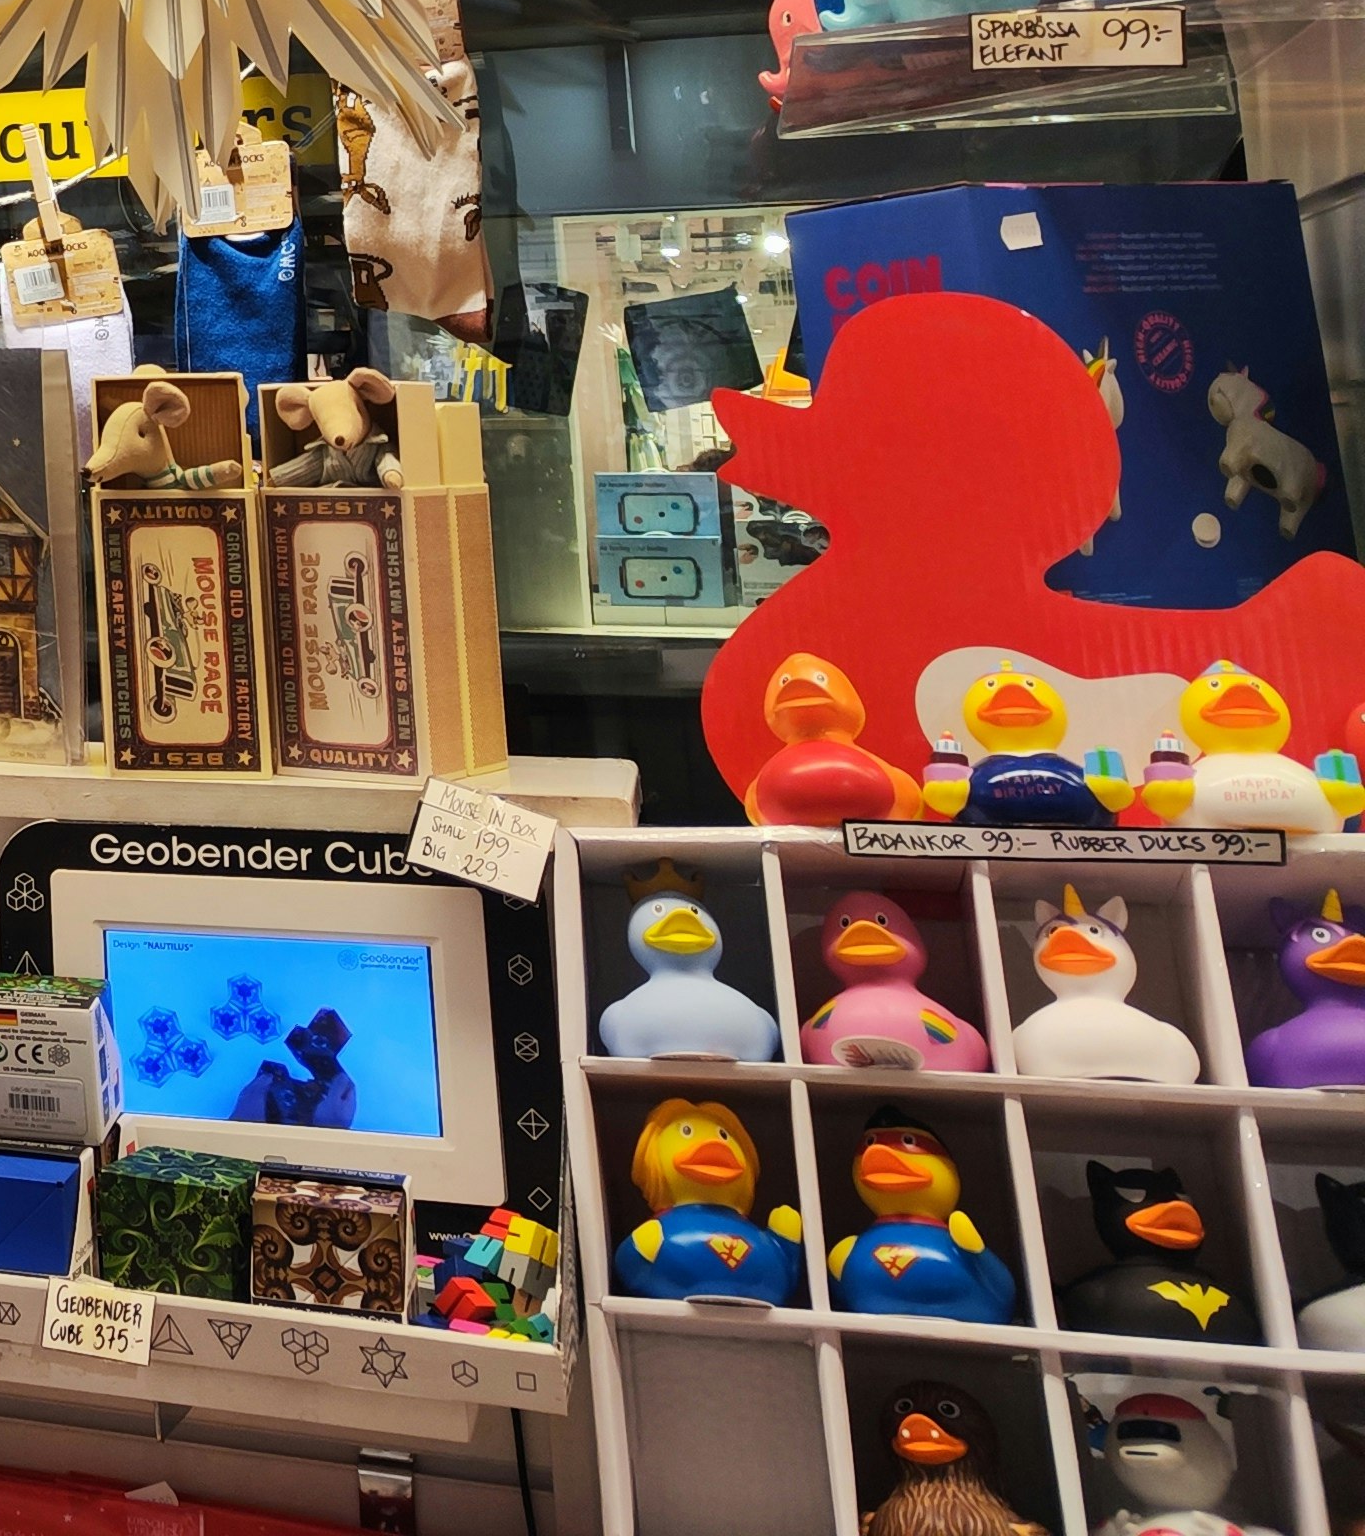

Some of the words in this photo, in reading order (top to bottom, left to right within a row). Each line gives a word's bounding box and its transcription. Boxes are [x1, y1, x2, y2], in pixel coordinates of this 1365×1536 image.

[977, 15, 1081, 41] SPARBÖSSA
[1102, 18, 1173, 51] 99:-
[979, 42, 1069, 65] ELEFANT
[241, 153, 264, 163] SOCKS
[62, 241, 88, 252] SOCKS
[129, 505, 213, 520] QUALITY
[298, 501, 367, 516] BEST
[108, 532, 122, 575] NEW
[226, 531, 243, 584] GRAND
[273, 526, 291, 589] FACTORY
[385, 527, 405, 614] MATCHES
[191, 557, 218, 643] MOUSE
[300, 552, 321, 616] RACE
[111, 579, 126, 650] SAFETY
[229, 589, 244, 619] OLD
[231, 623, 248, 673] MATCH
[303, 622, 329, 711] MOUSE
[391, 619, 407, 692] SAFETY
[115, 654, 132, 740] MATCHES
[200, 650, 223, 714] RACE
[235, 678, 253, 741] FACTORY
[397, 696, 411, 740] NEW
[149, 751, 223, 765] BEST
[309, 749, 389, 767] QUALITY
[993, 783, 1063, 799] BIRTHDAY
[1224, 788, 1296, 804] BIRTHDAY
[1231, 777, 1282, 790] HAPPY
[431, 815, 466, 840] SMALL
[439, 786, 481, 820] MOUSE
[488, 808, 506, 827] IN
[510, 815, 537, 841] BOX
[90, 833, 313, 871] Geobender
[421, 836, 446, 861] BIG
[852, 827, 973, 851] BADANKOR
[981, 831, 1037, 853] 99:-
[1051, 833, 1134, 854] RUBBER
[1138, 834, 1207, 853] DUCKS
[1211, 834, 1271, 855] 99:-
[112, 940, 140, 952] Design
[56, 1284, 143, 1329] GEOBENDER
[50, 1319, 84, 1346] CUBE
